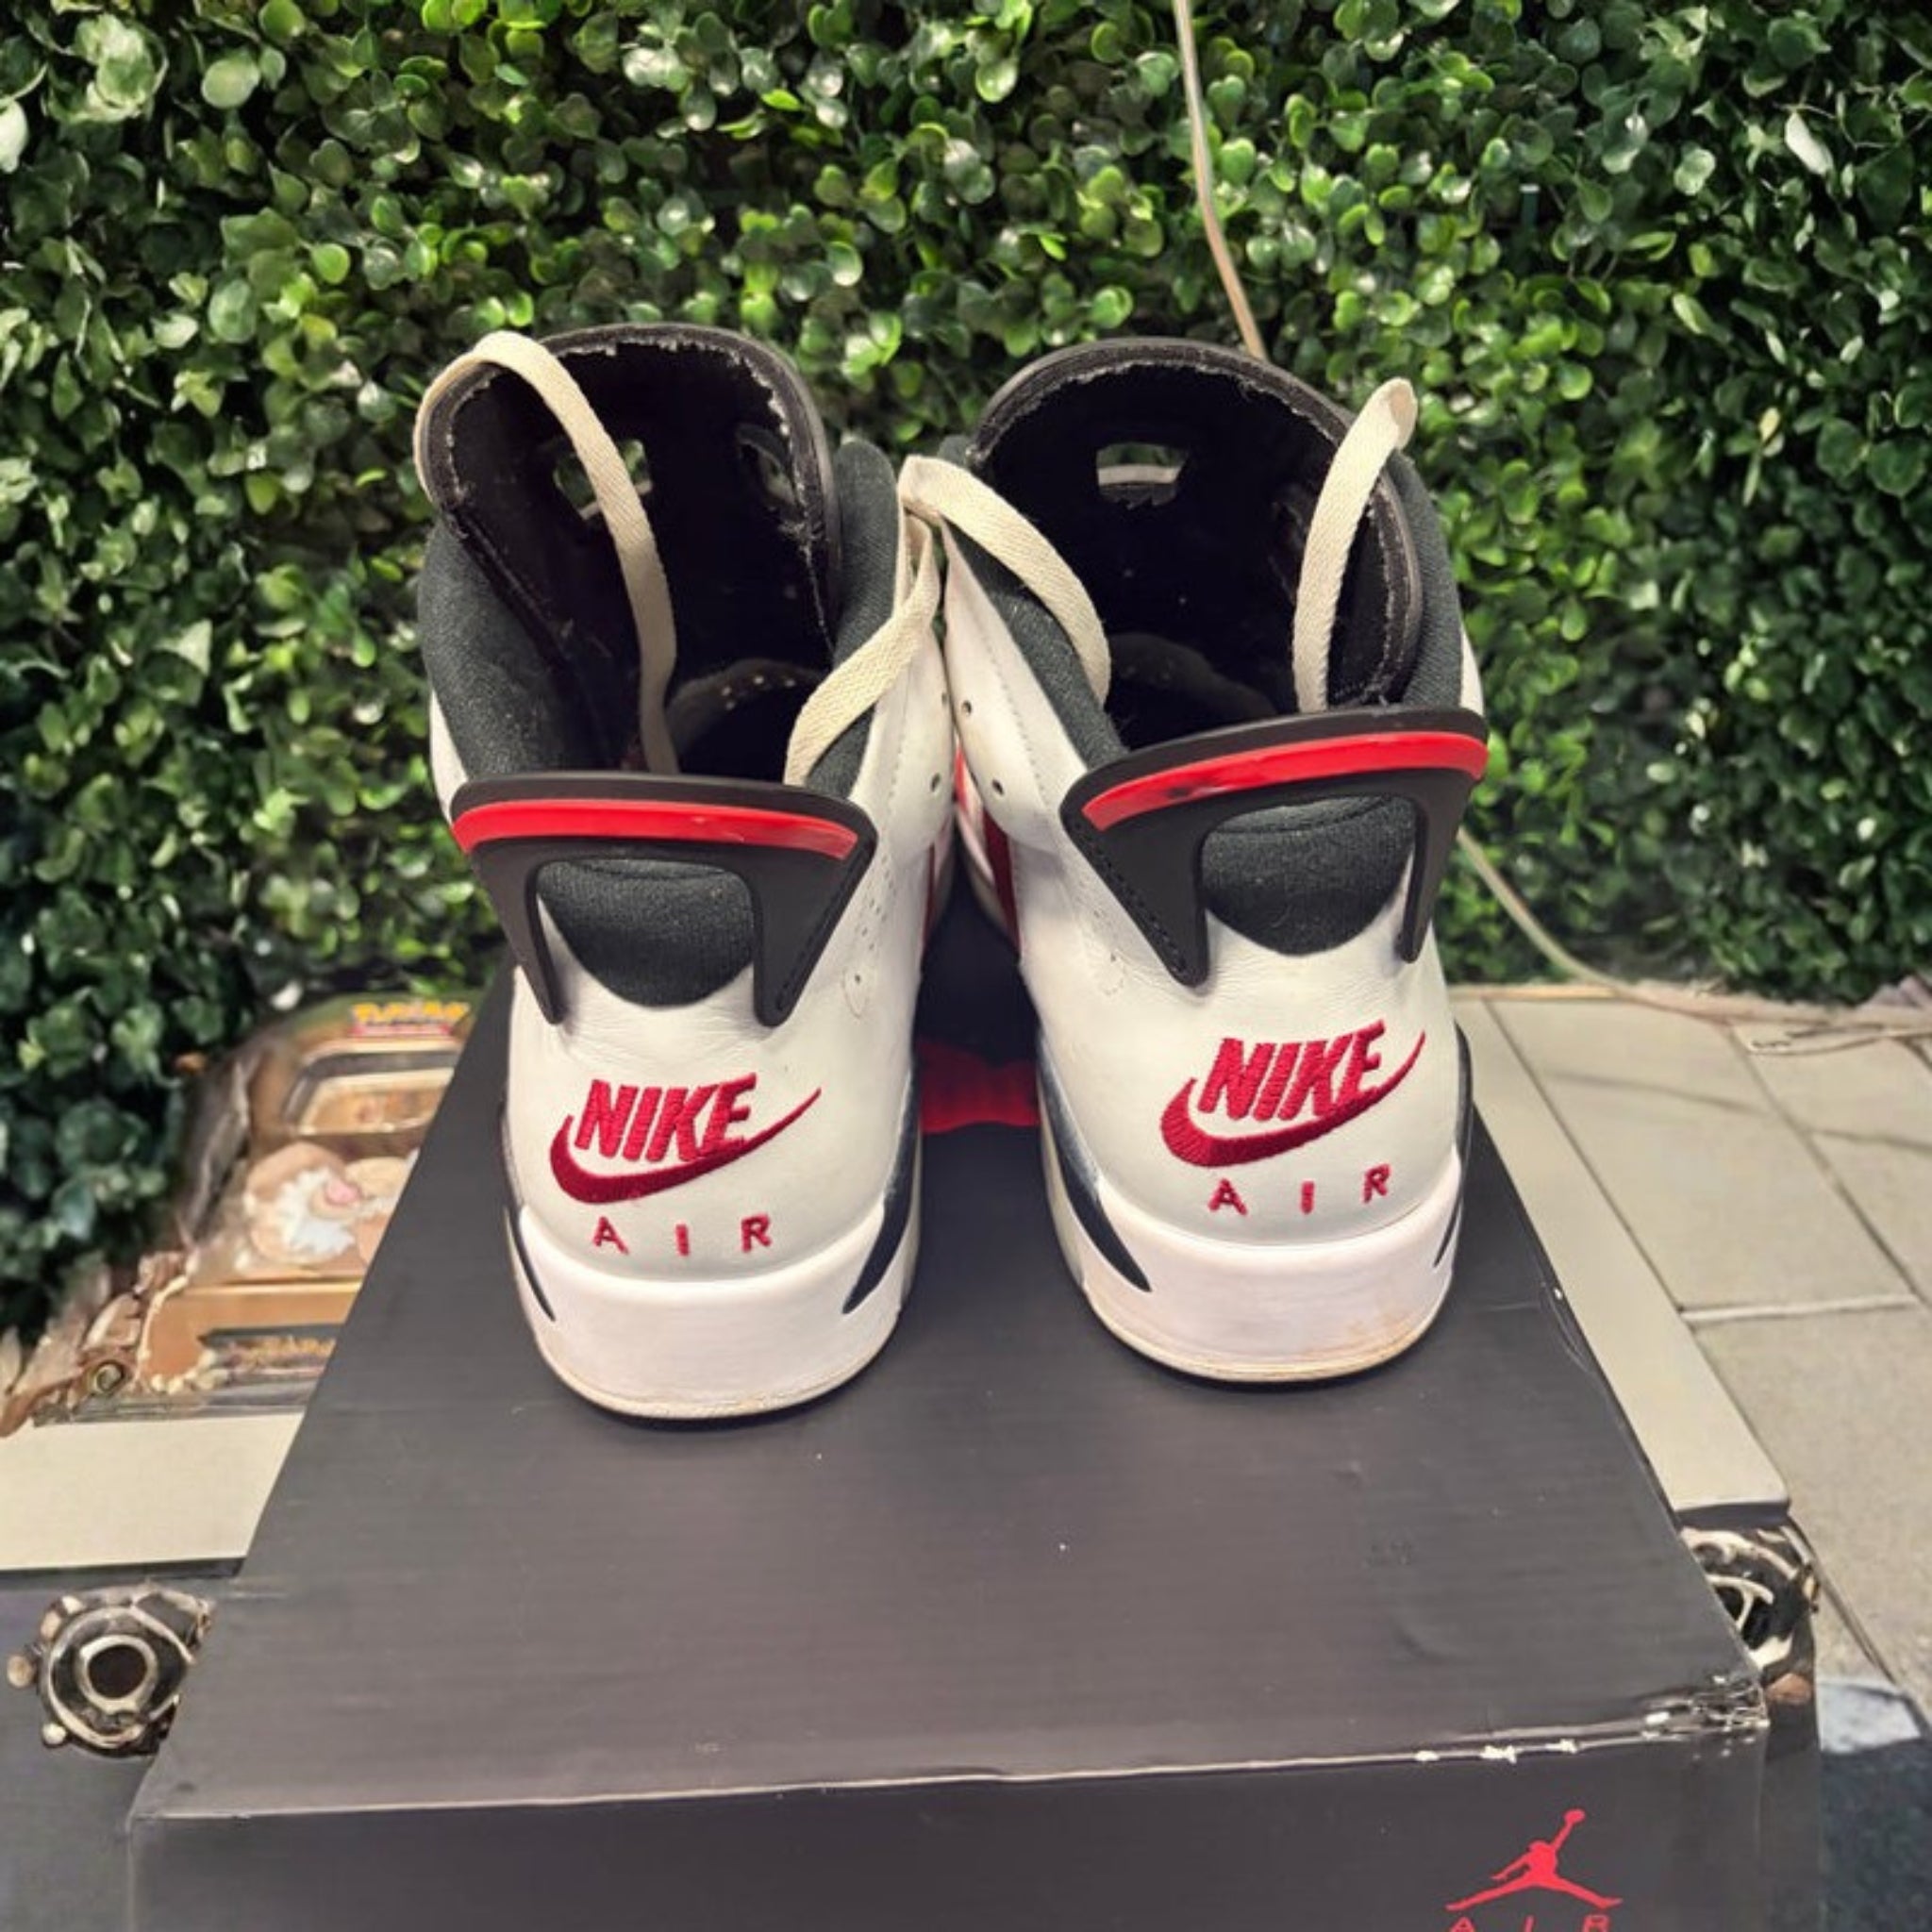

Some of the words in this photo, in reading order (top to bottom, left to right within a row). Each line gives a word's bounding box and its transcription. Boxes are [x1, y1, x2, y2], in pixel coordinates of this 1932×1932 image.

[1197, 1018, 1386, 1122] NIKE
[574, 1071, 758, 1162] NIKE
[1208, 1163, 1392, 1217] AIR
[591, 1213, 773, 1256] AIR
